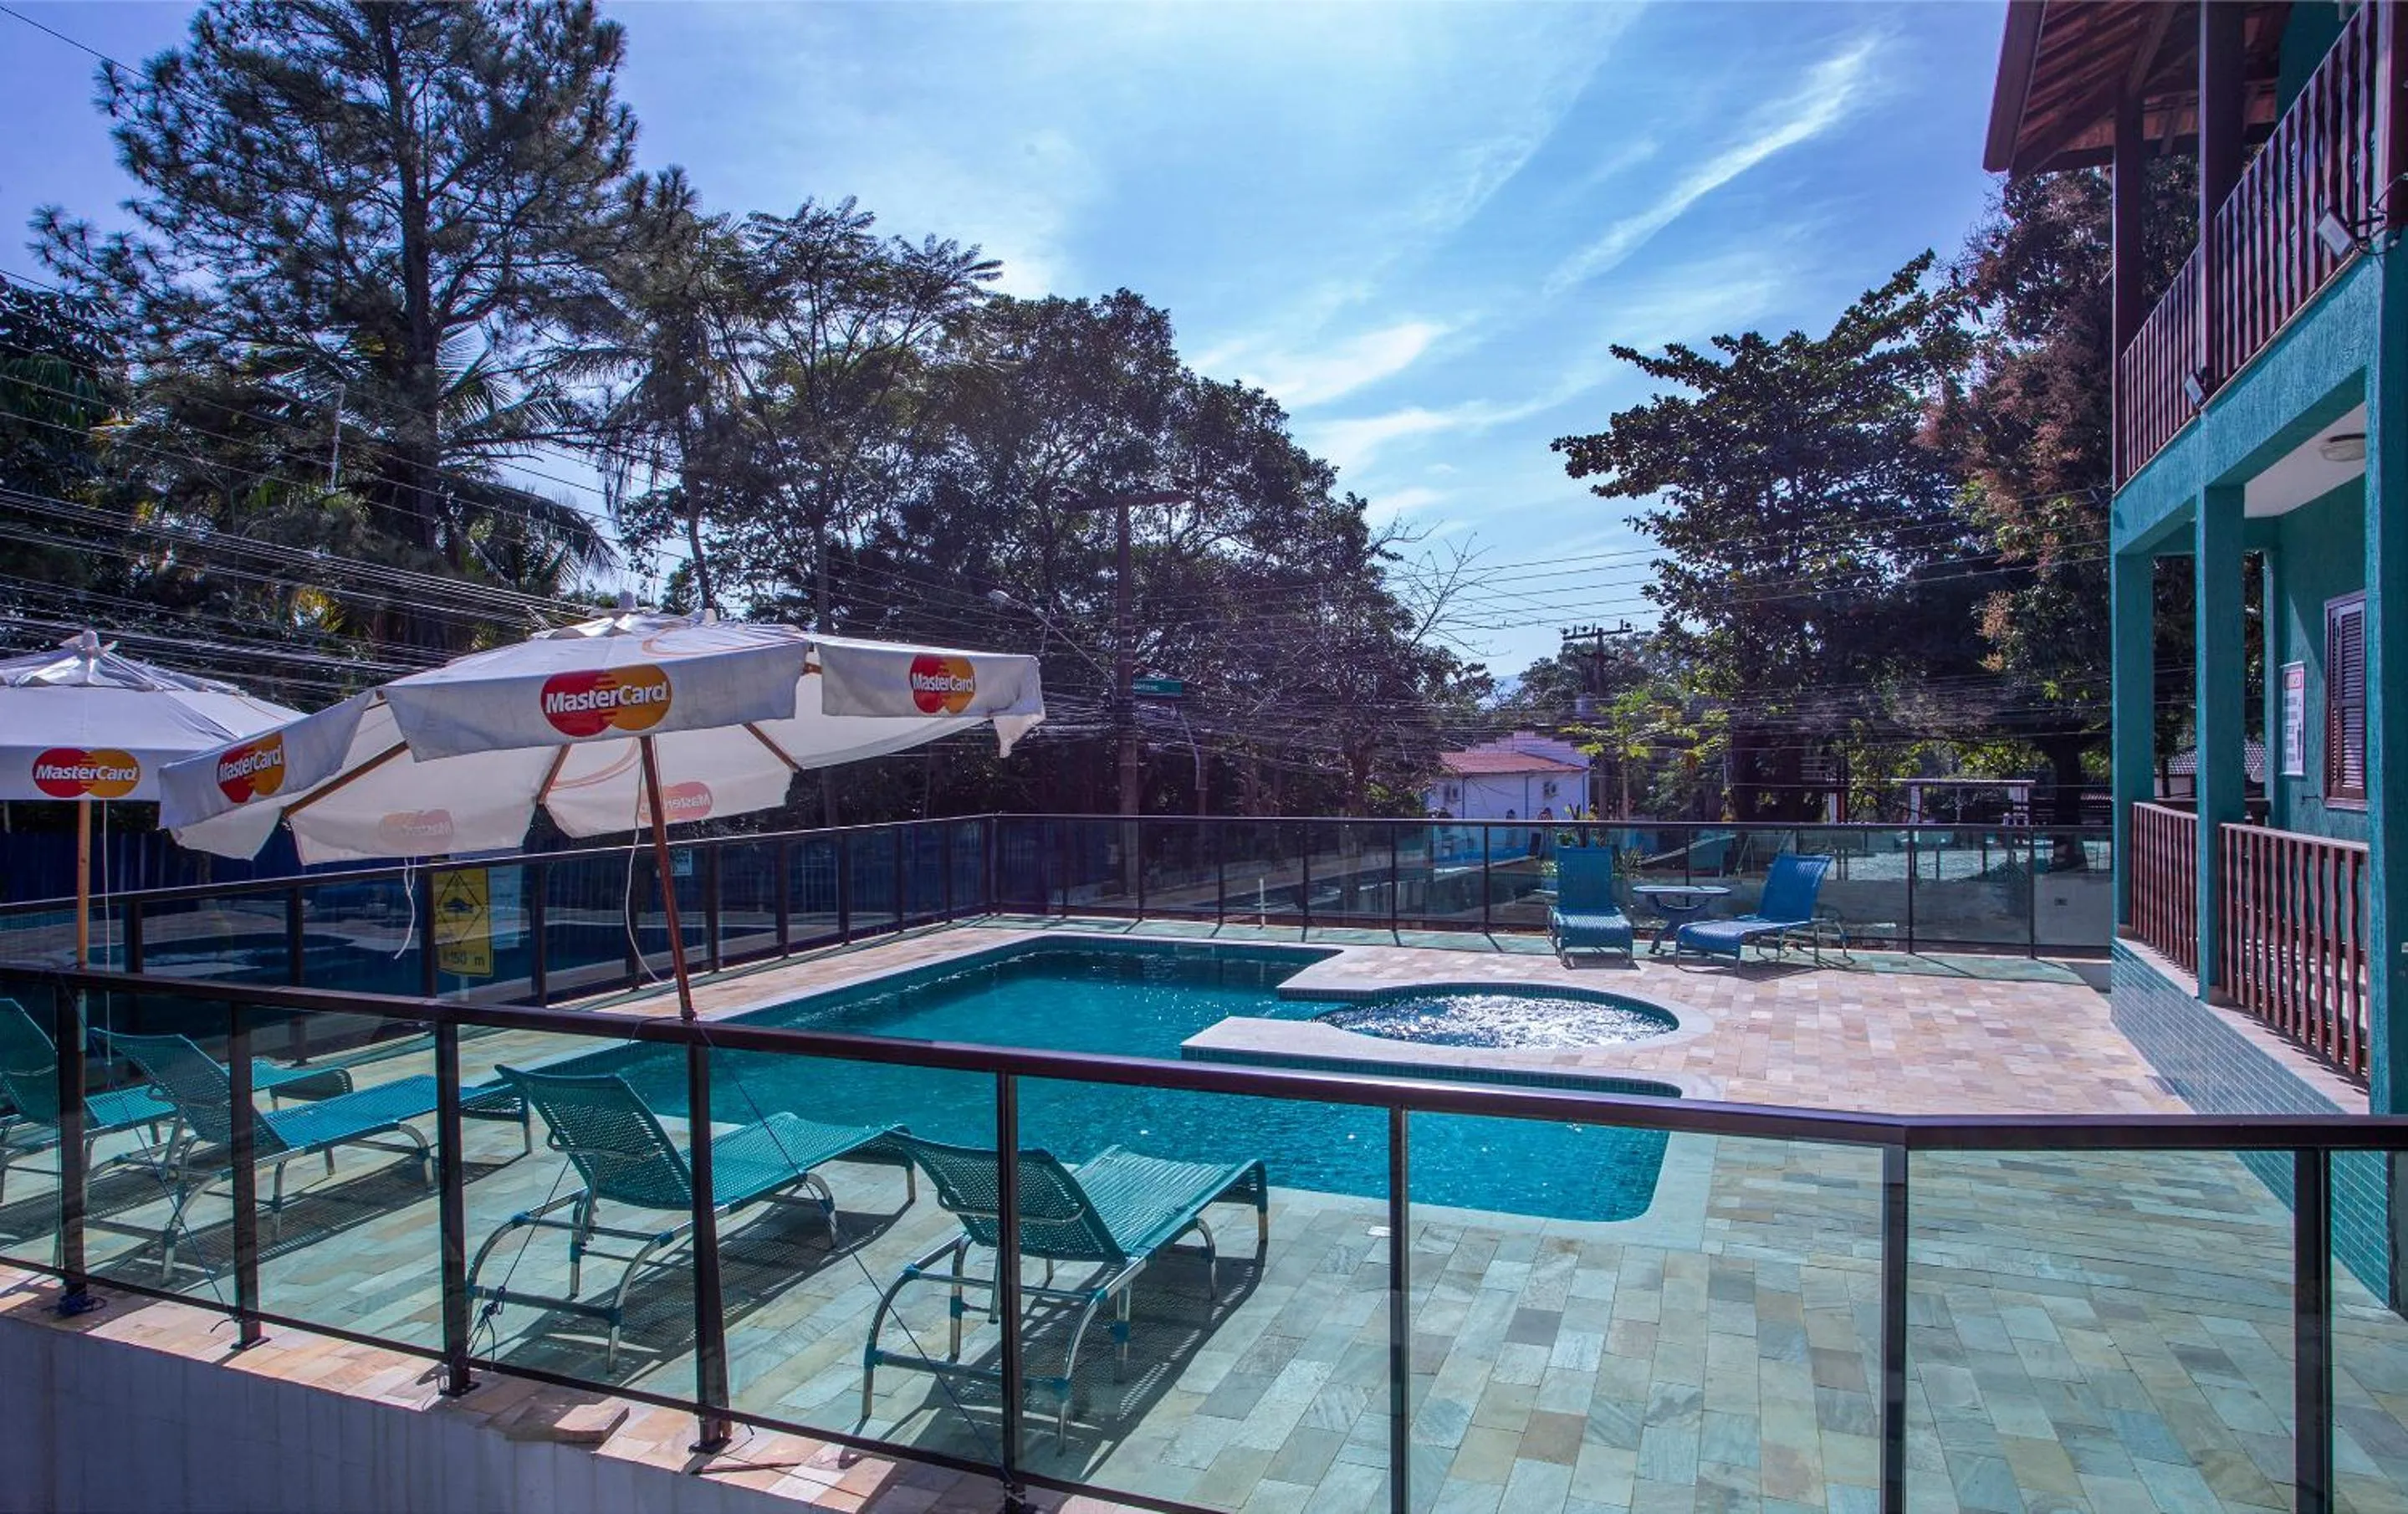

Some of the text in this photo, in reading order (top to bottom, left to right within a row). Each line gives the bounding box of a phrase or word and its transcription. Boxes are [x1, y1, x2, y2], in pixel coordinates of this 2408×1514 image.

[912, 673, 974, 692] MasterCard
[546, 682, 667, 714] MasterCard
[35, 765, 138, 781] MasterCard
[217, 744, 282, 783] MasterCard
